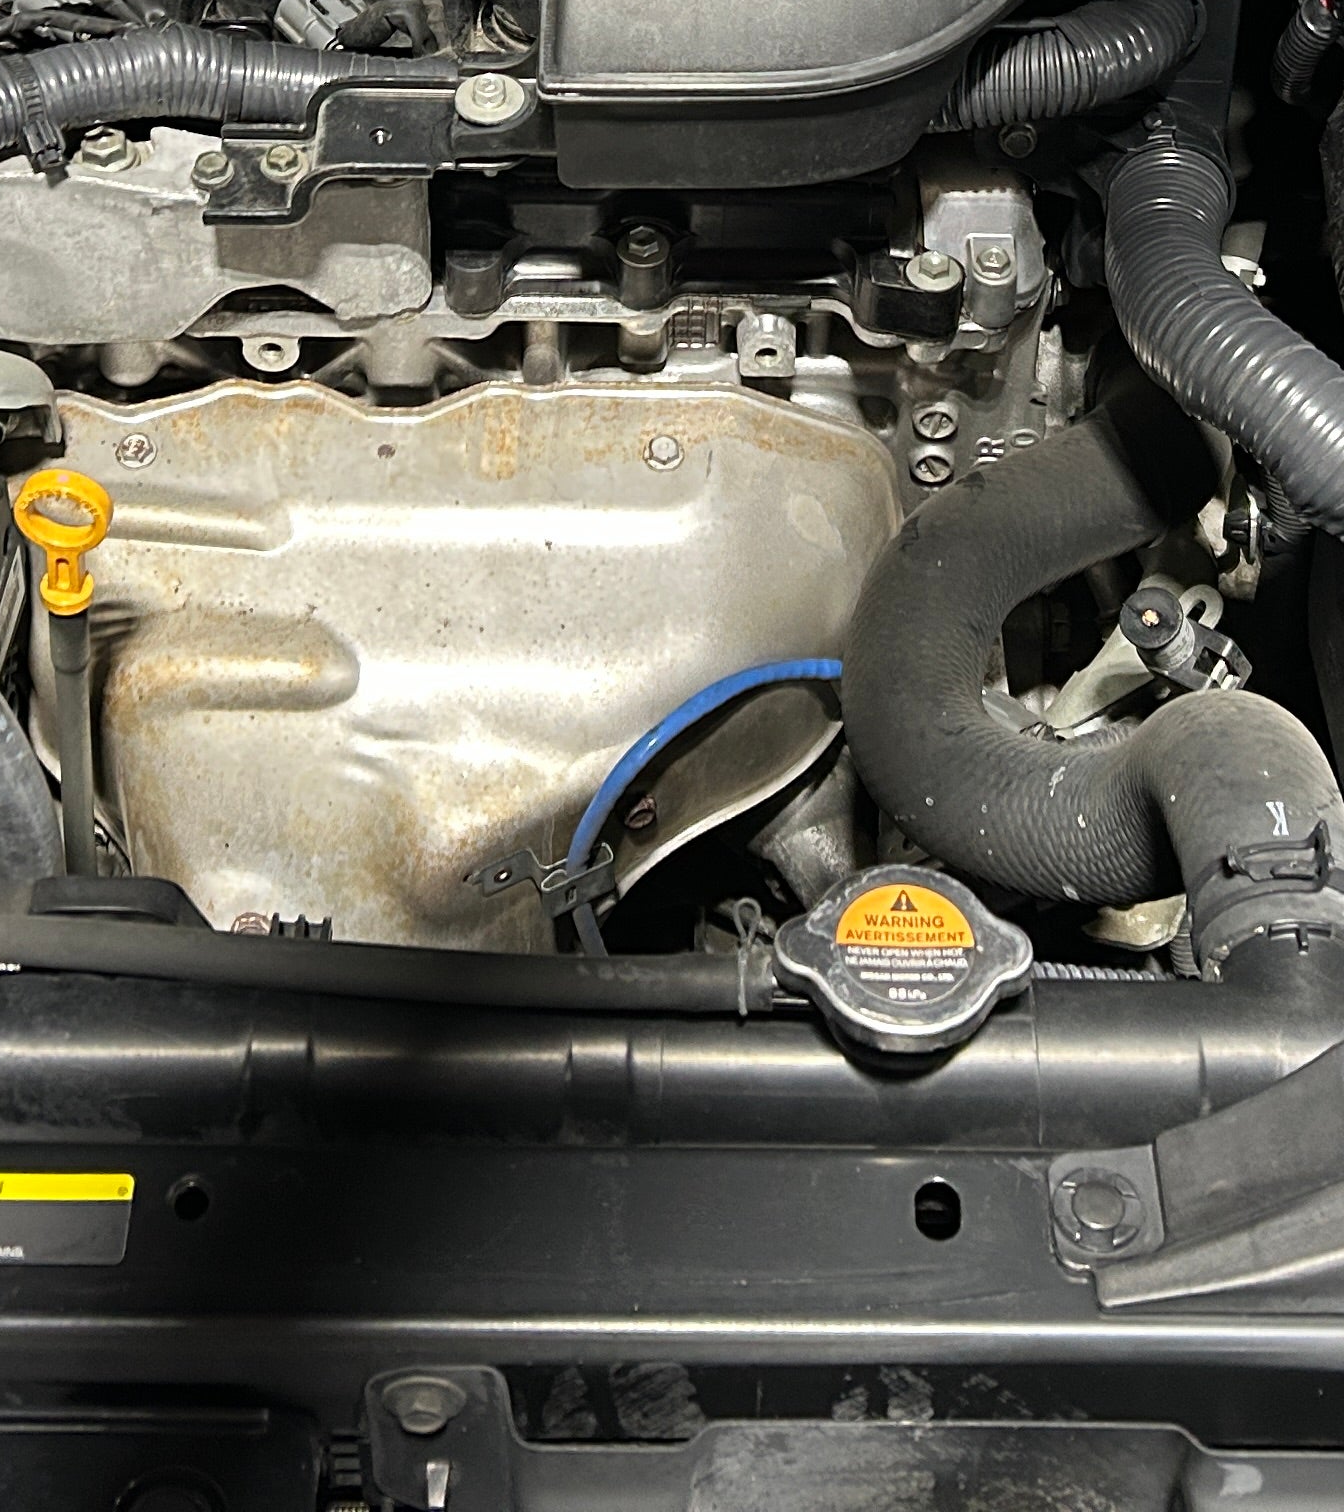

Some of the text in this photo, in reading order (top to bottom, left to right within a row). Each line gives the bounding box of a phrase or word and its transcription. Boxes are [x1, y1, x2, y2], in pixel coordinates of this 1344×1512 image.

[864, 914, 945, 928] WARNING
[846, 930, 966, 944] AVERTISSEMENT
[847, 946, 879, 956] NEVER
[881, 947, 909, 957] OPEN
